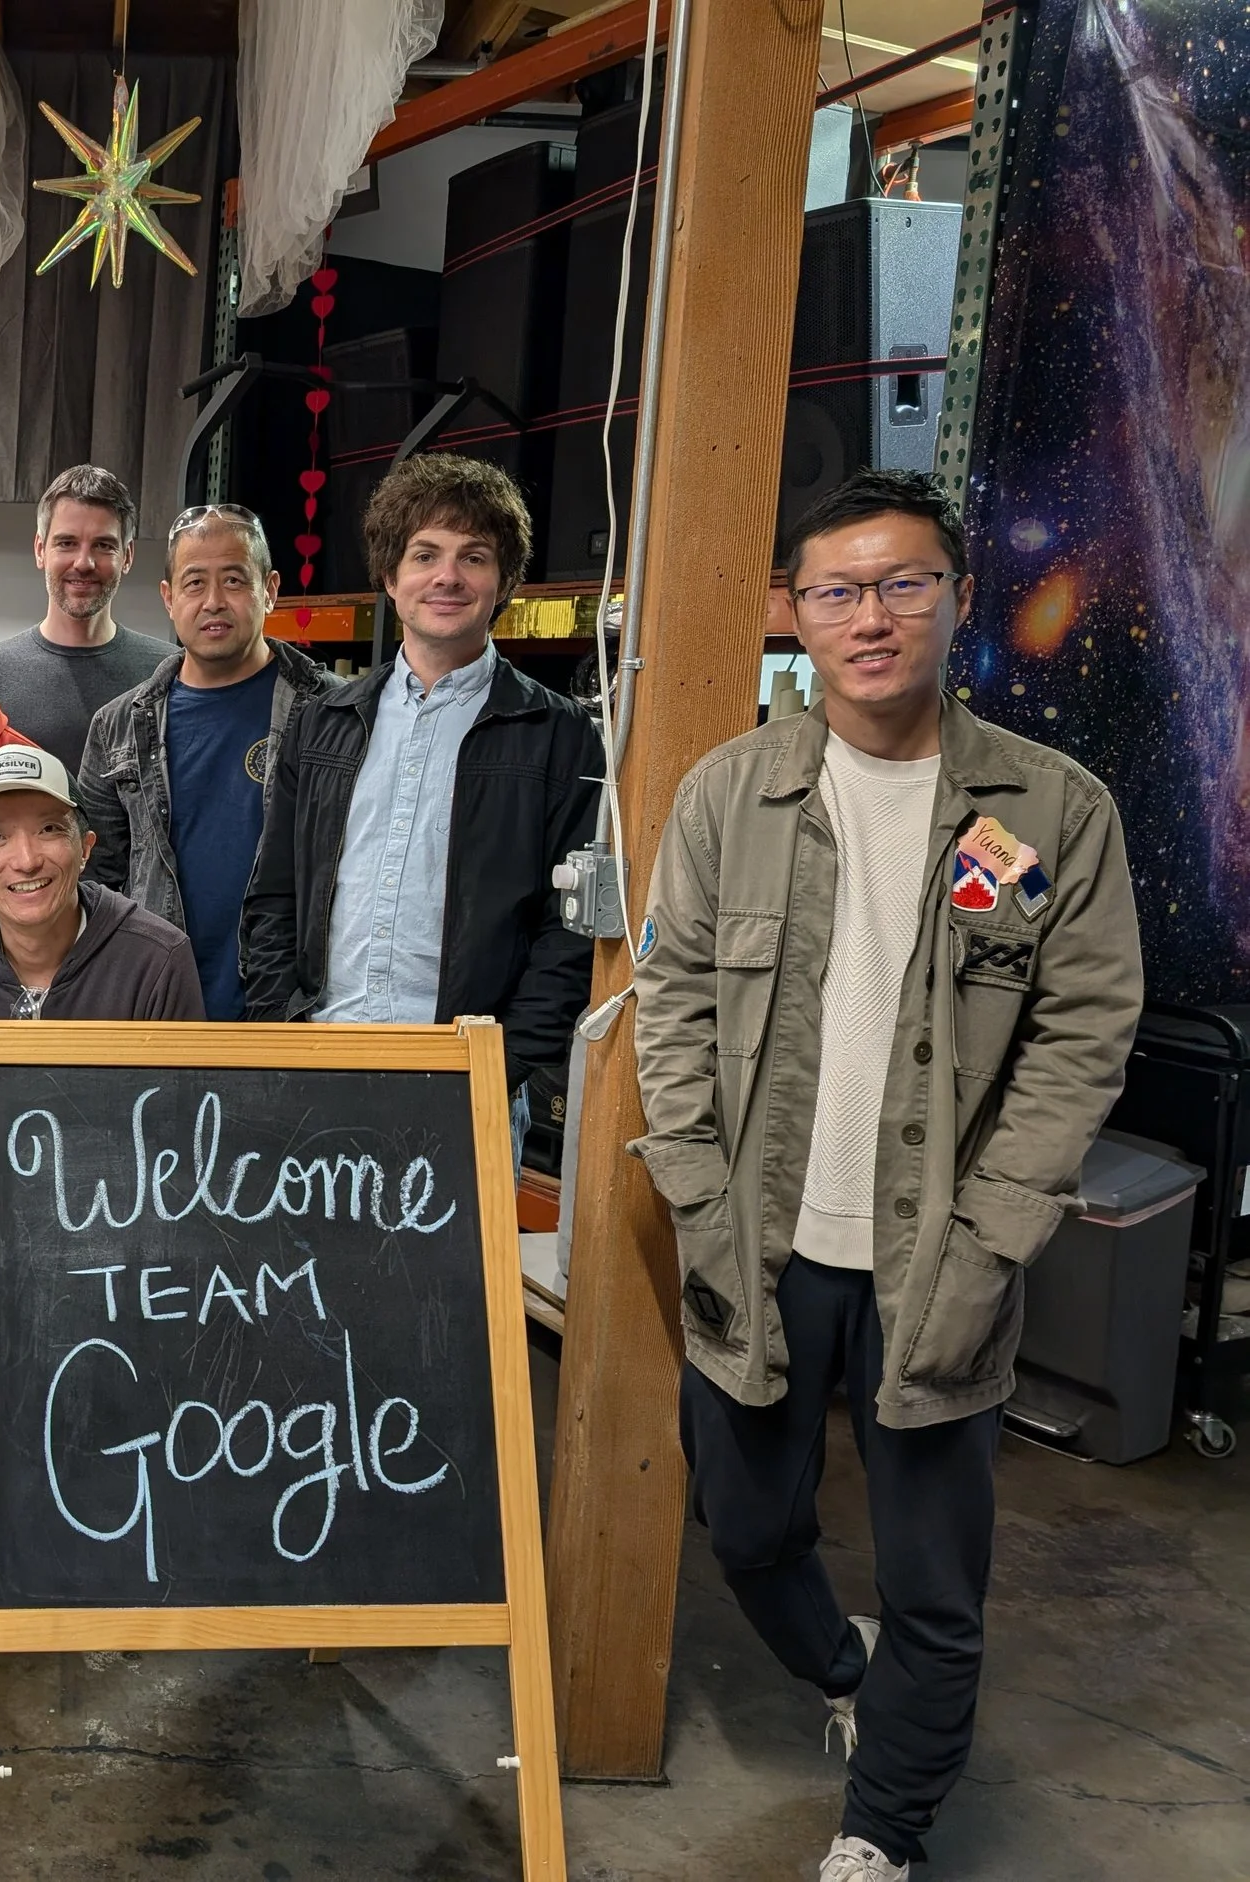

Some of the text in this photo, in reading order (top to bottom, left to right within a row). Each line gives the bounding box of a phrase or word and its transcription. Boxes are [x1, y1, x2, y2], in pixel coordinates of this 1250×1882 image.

[7, 1086, 457, 1234] Welcome
[66, 1257, 326, 1326] TEAM
[43, 1328, 449, 1583] Google
